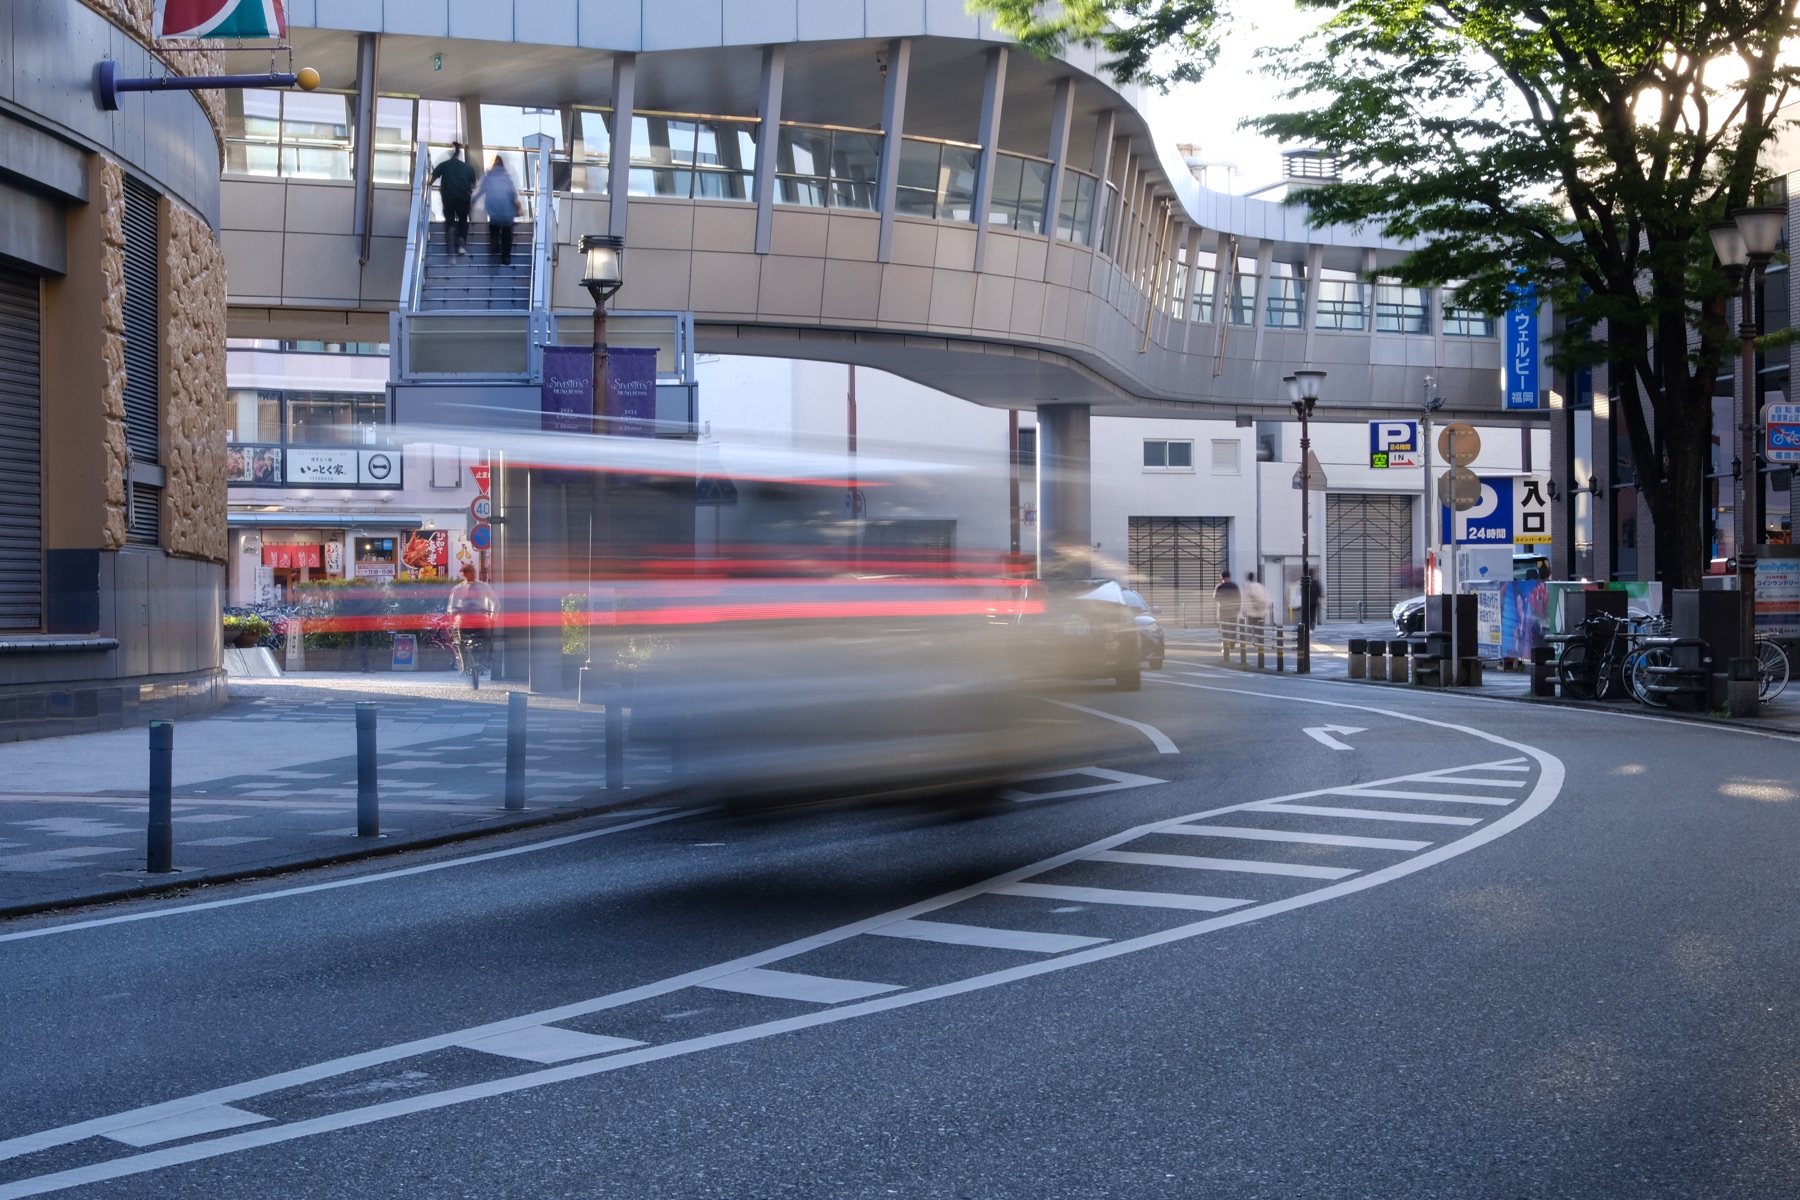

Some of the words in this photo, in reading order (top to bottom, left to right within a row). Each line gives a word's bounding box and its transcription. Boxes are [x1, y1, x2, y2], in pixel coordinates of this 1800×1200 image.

[1515, 313, 1530, 390] ウェルビー
[1511, 391, 1534, 404] 福岡
[1378, 423, 1411, 451] P
[1372, 453, 1388, 468] 空
[475, 471, 490, 479] 止ま
[476, 503, 490, 515] 40
[1468, 527, 1506, 539] 24時間
